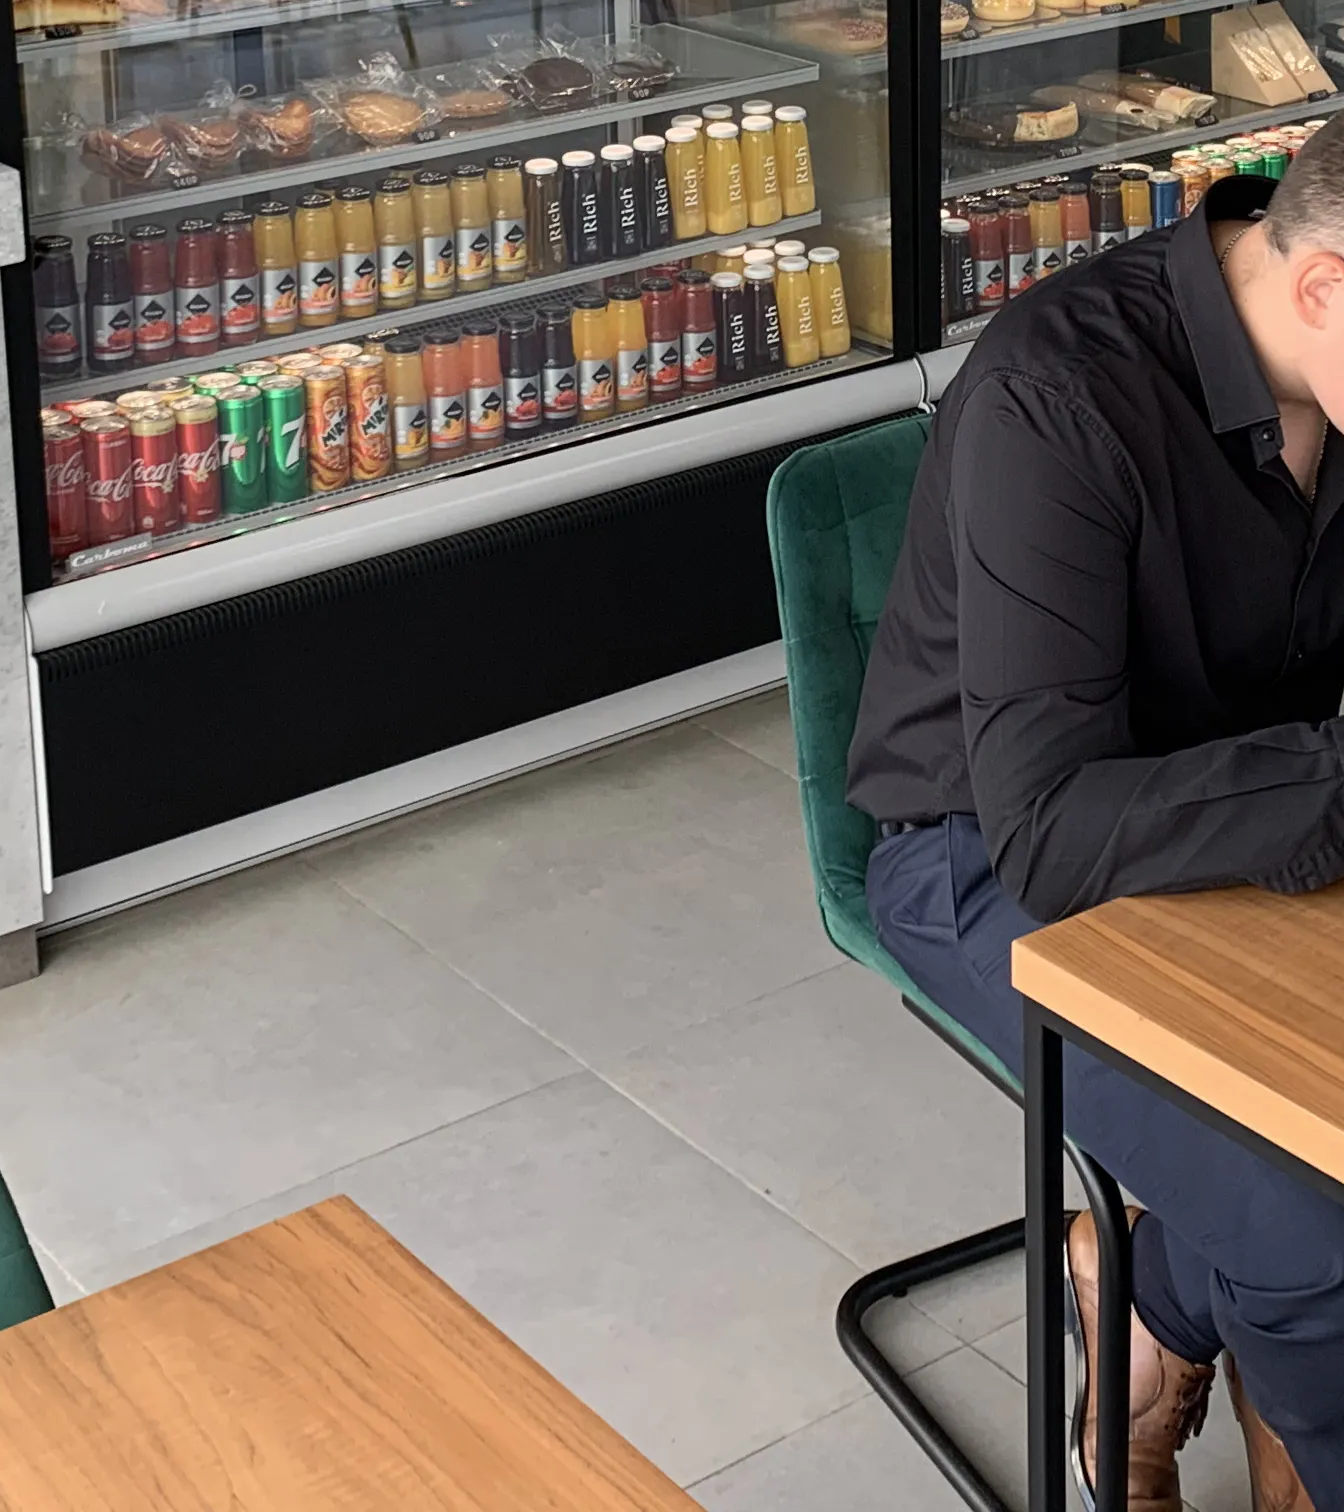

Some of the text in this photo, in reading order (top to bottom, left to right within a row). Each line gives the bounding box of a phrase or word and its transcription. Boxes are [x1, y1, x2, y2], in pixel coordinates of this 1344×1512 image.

[729, 162, 742, 202] Rich
[764, 155, 777, 195] Rich
[795, 145, 809, 184] Rich
[622, 187, 635, 228] Rich
[656, 177, 669, 217] Rich
[684, 167, 698, 208] Rich
[583, 193, 597, 234] Rich
[962, 257, 974, 296] Rich
[765, 304, 780, 345] Rich
[798, 295, 813, 335] Rich
[830, 286, 845, 325] Rich
[730, 313, 745, 354] Rich
